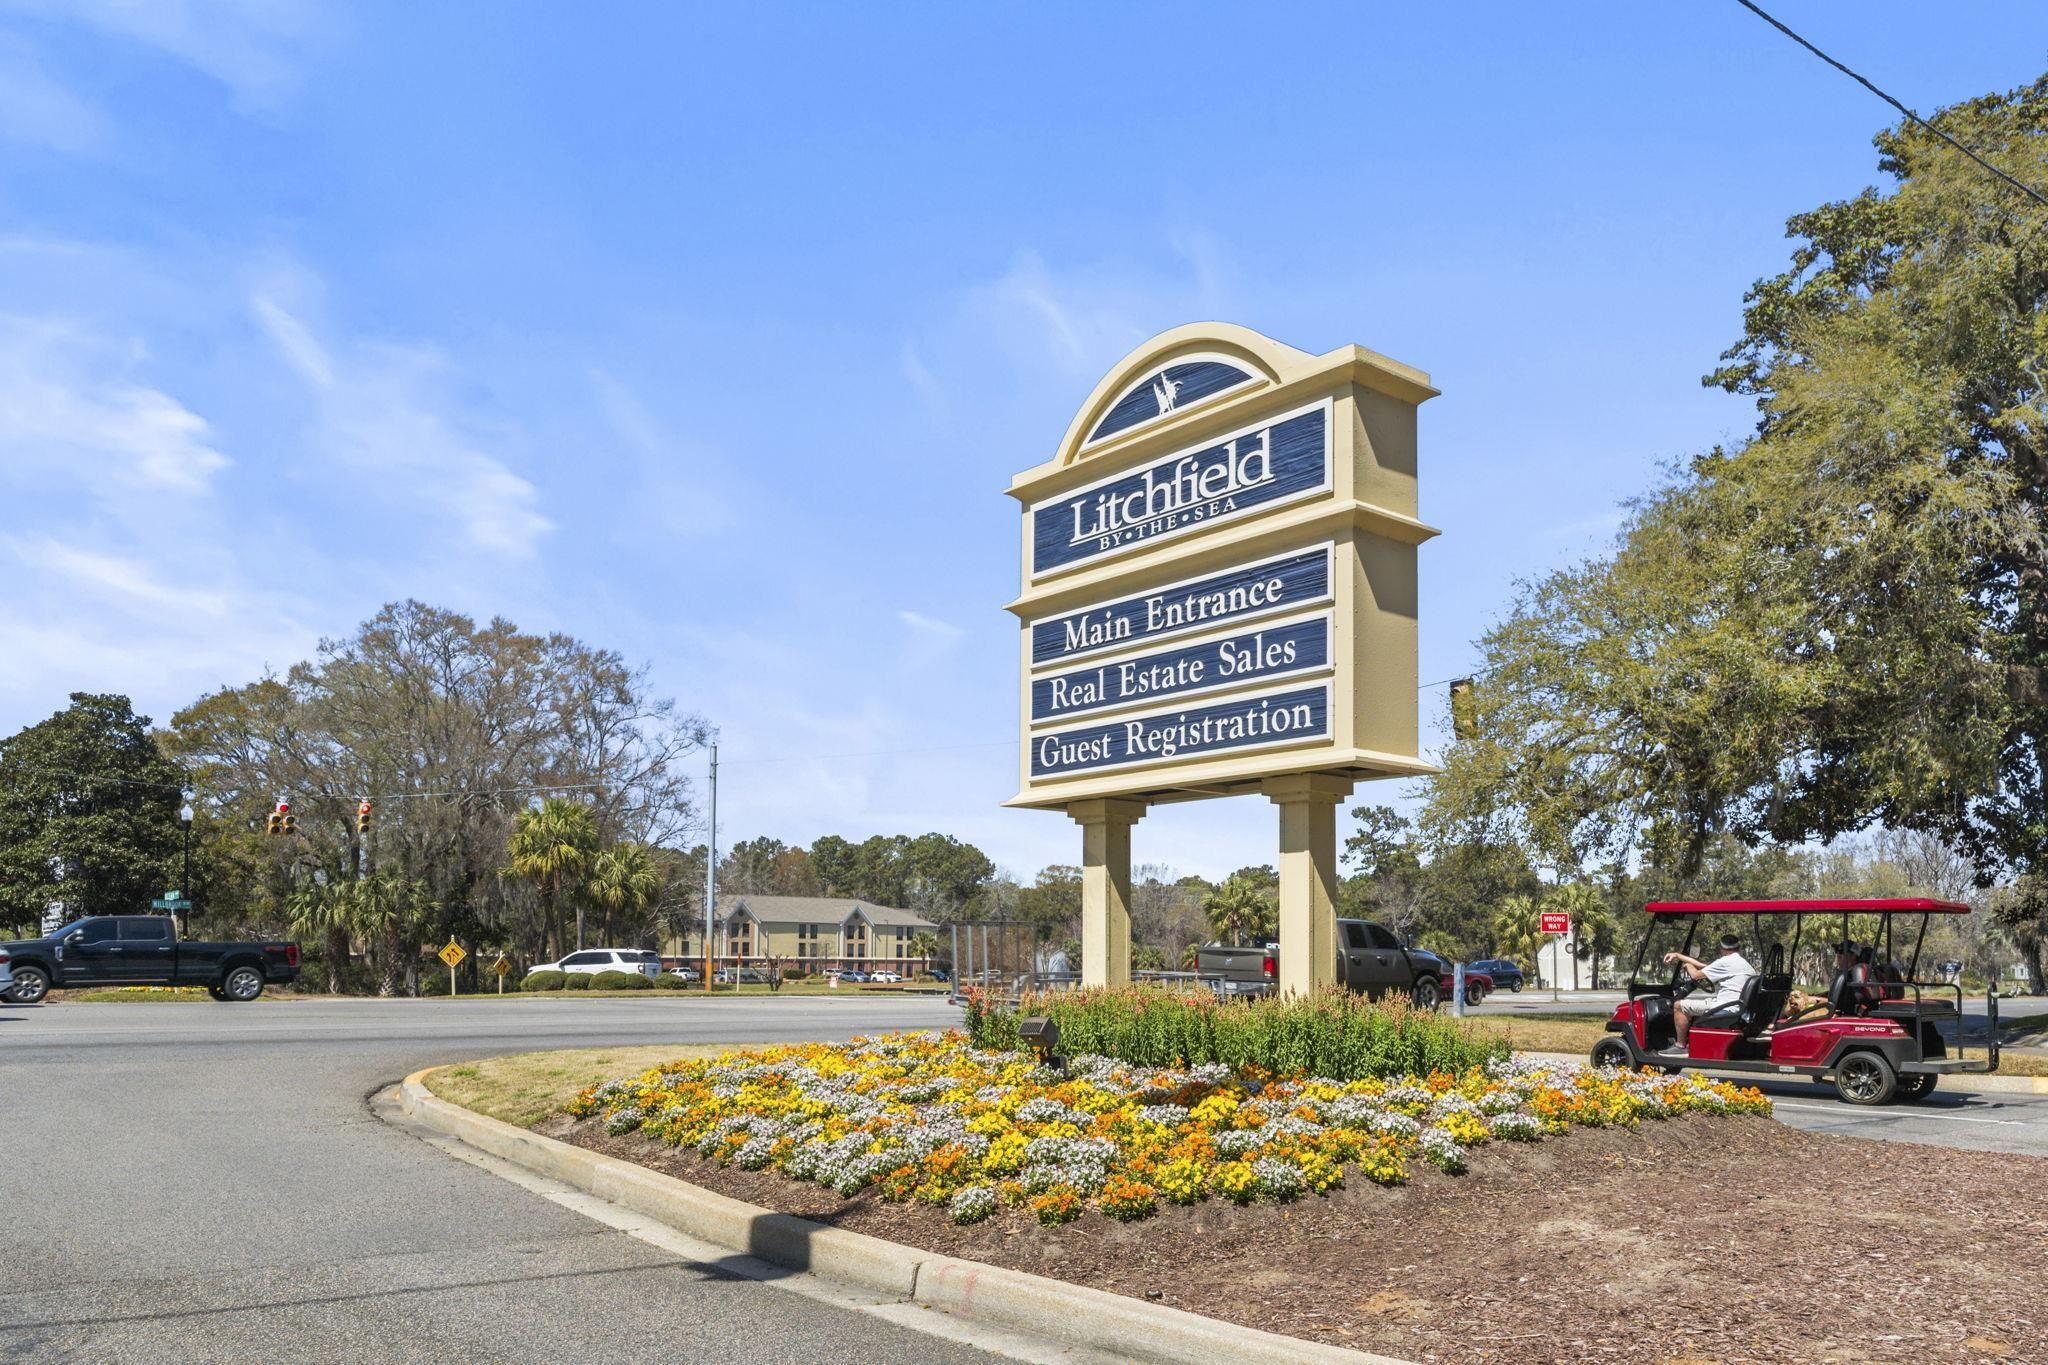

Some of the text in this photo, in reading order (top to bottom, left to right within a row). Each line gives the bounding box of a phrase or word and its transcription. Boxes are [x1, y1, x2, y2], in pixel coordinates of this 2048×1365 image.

[1070, 428, 1275, 544] Litchfield
[1063, 577, 1283, 652] Main Entrance
[1050, 633, 1297, 711] Real Estate Sales
[1040, 700, 1314, 768] Guest Registration
[1543, 915, 1566, 923] WRONG
